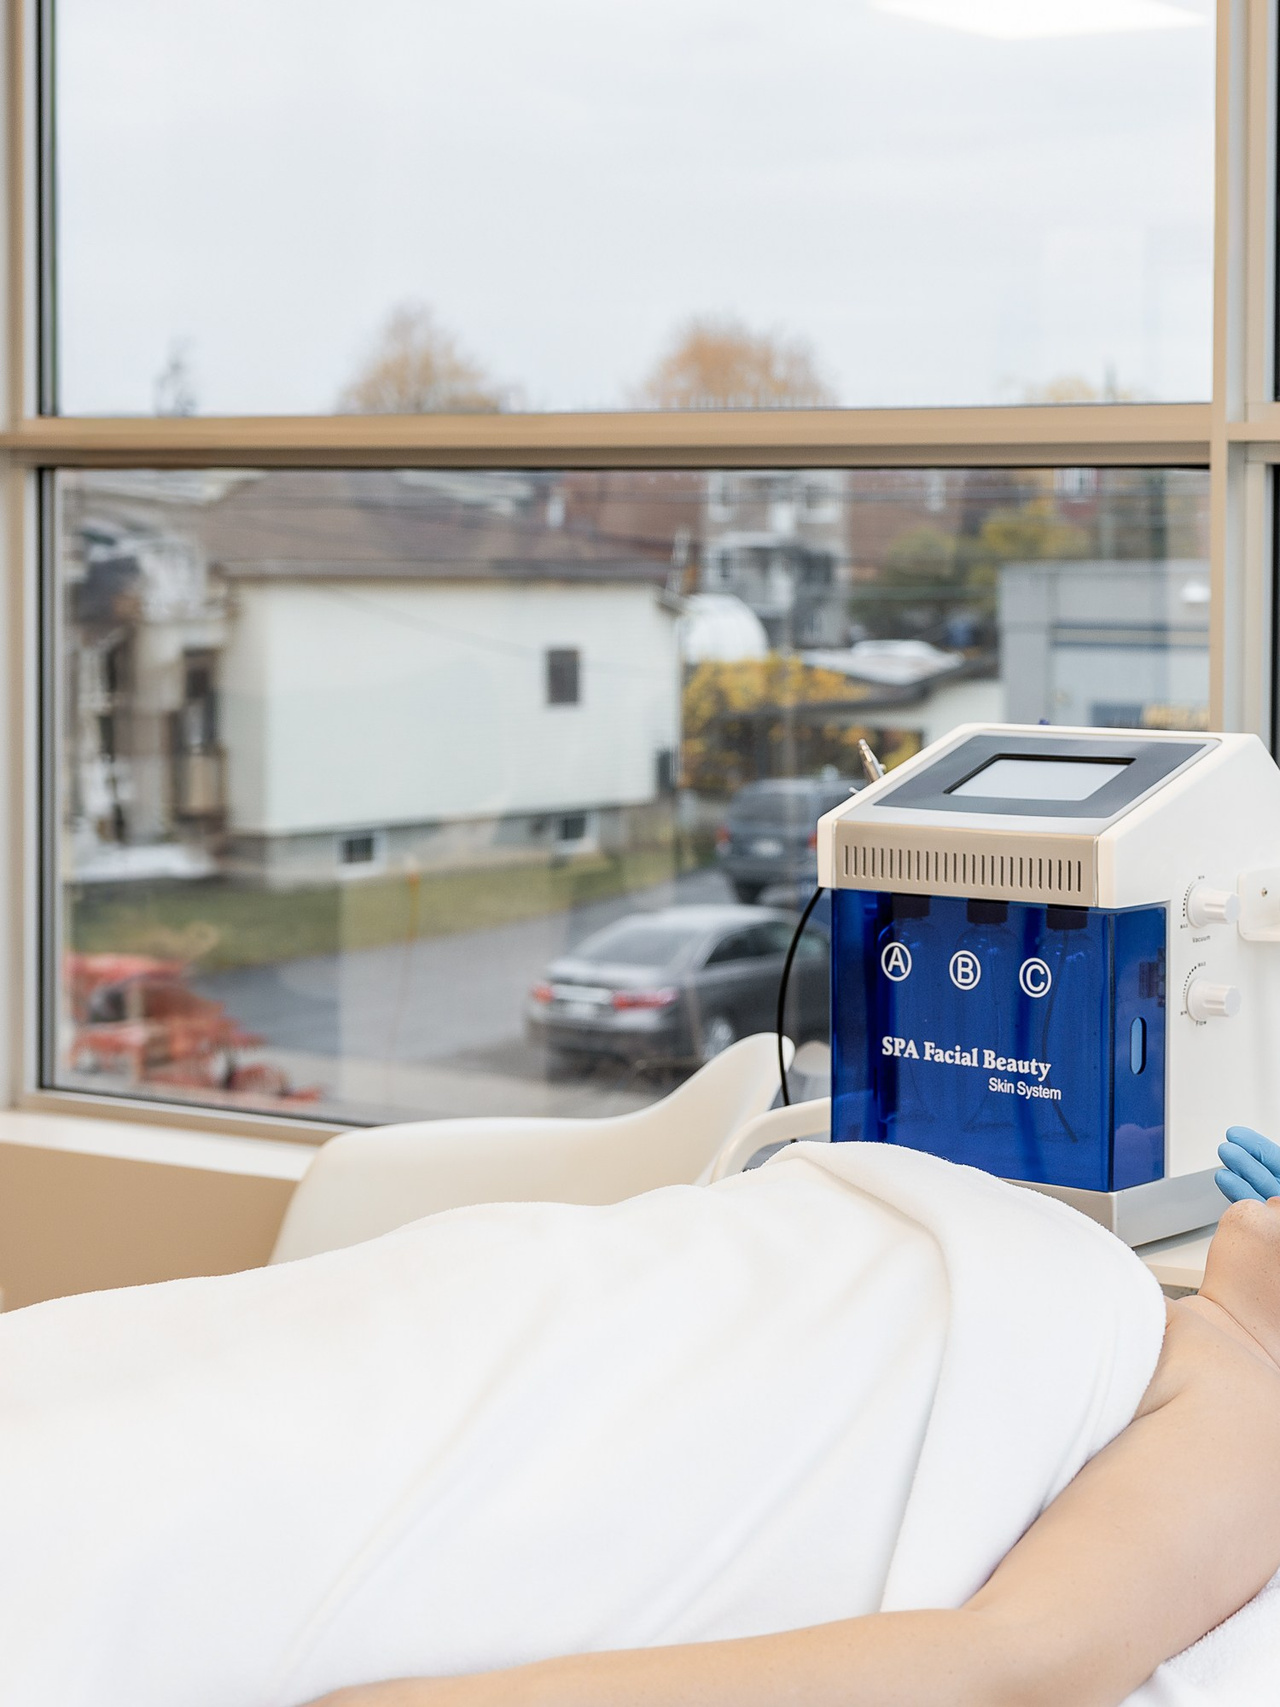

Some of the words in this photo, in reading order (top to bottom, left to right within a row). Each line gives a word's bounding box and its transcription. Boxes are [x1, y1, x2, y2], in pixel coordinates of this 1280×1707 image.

[885, 944, 908, 976] A
[954, 953, 977, 986] B
[1023, 962, 1048, 994] C
[881, 1036, 920, 1060] SPA
[923, 1041, 979, 1068] Facial
[982, 1049, 1052, 1082] Beauty
[988, 1077, 1015, 1094] Skin
[1016, 1081, 1062, 1100] System
